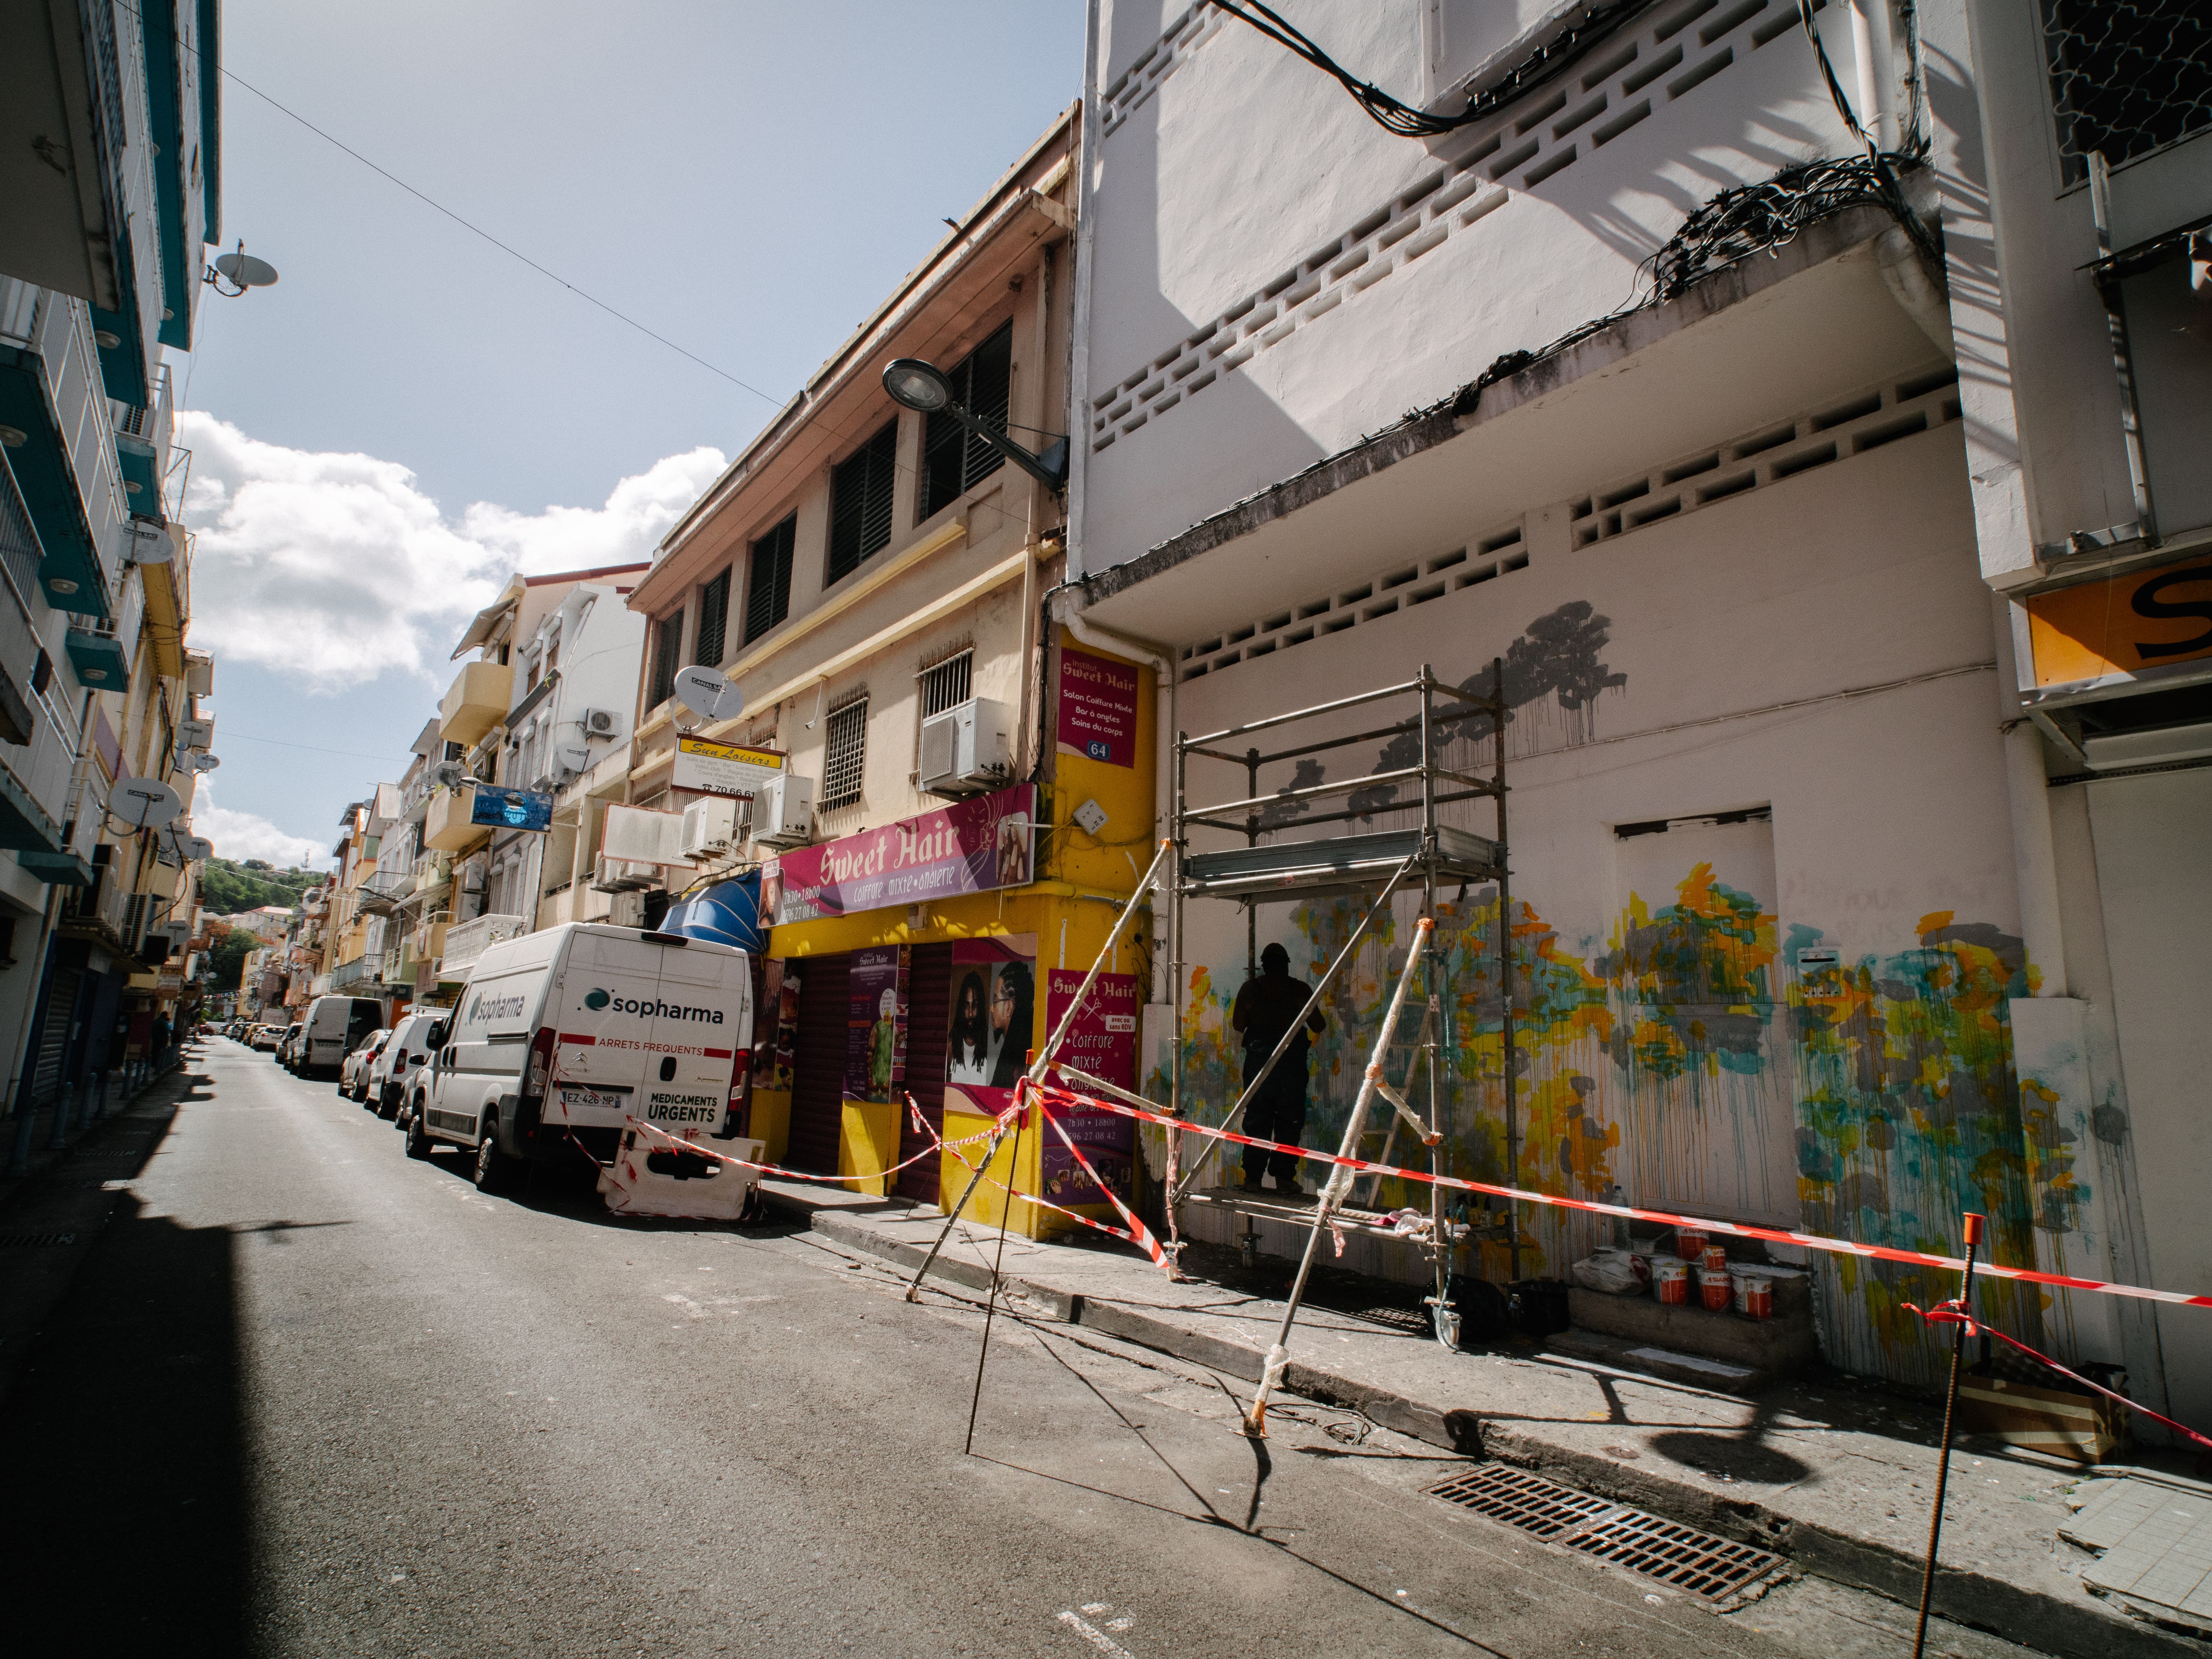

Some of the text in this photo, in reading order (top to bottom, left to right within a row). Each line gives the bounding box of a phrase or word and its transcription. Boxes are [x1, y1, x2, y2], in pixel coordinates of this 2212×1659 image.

[1073, 660, 1097, 672] Institut
[693, 678, 724, 691] CANALSA
[1063, 662, 1135, 691] Sweet Hair
[1064, 690, 1132, 713] Salon Coiffure Mixte
[1076, 706, 1088, 716] Bar
[1097, 713, 1120, 723] ongles
[1072, 718, 1091, 728] Soins
[1104, 727, 1123, 736] corps
[690, 742, 769, 765] Sun Loisirs
[1091, 744, 1106, 757] 64
[727, 769, 743, 777] Stages
[820, 819, 959, 885] Sweet Hair
[854, 866, 955, 902] coiffure mixte onglerie
[782, 903, 818, 922] 0596 27 08 42
[860, 955, 888, 965] Sweet Hair
[1102, 981, 1135, 997] Hair
[478, 992, 525, 1025] sopharma
[612, 998, 723, 1024] sopharma
[599, 1038, 702, 1056] ARRETS FREQUENTS
[1073, 1035, 1114, 1048] coiffure
[1072, 1056, 1102, 1069] mixte
[651, 1093, 718, 1106] MEDICAMENTS
[648, 1105, 716, 1123] URGENTS
[1068, 1118, 1115, 1127] 7h30 18h00
[1084, 1132, 1092, 1140] 27
[1096, 1132, 1104, 1140] 08
[1107, 1131, 1115, 1140] 42
